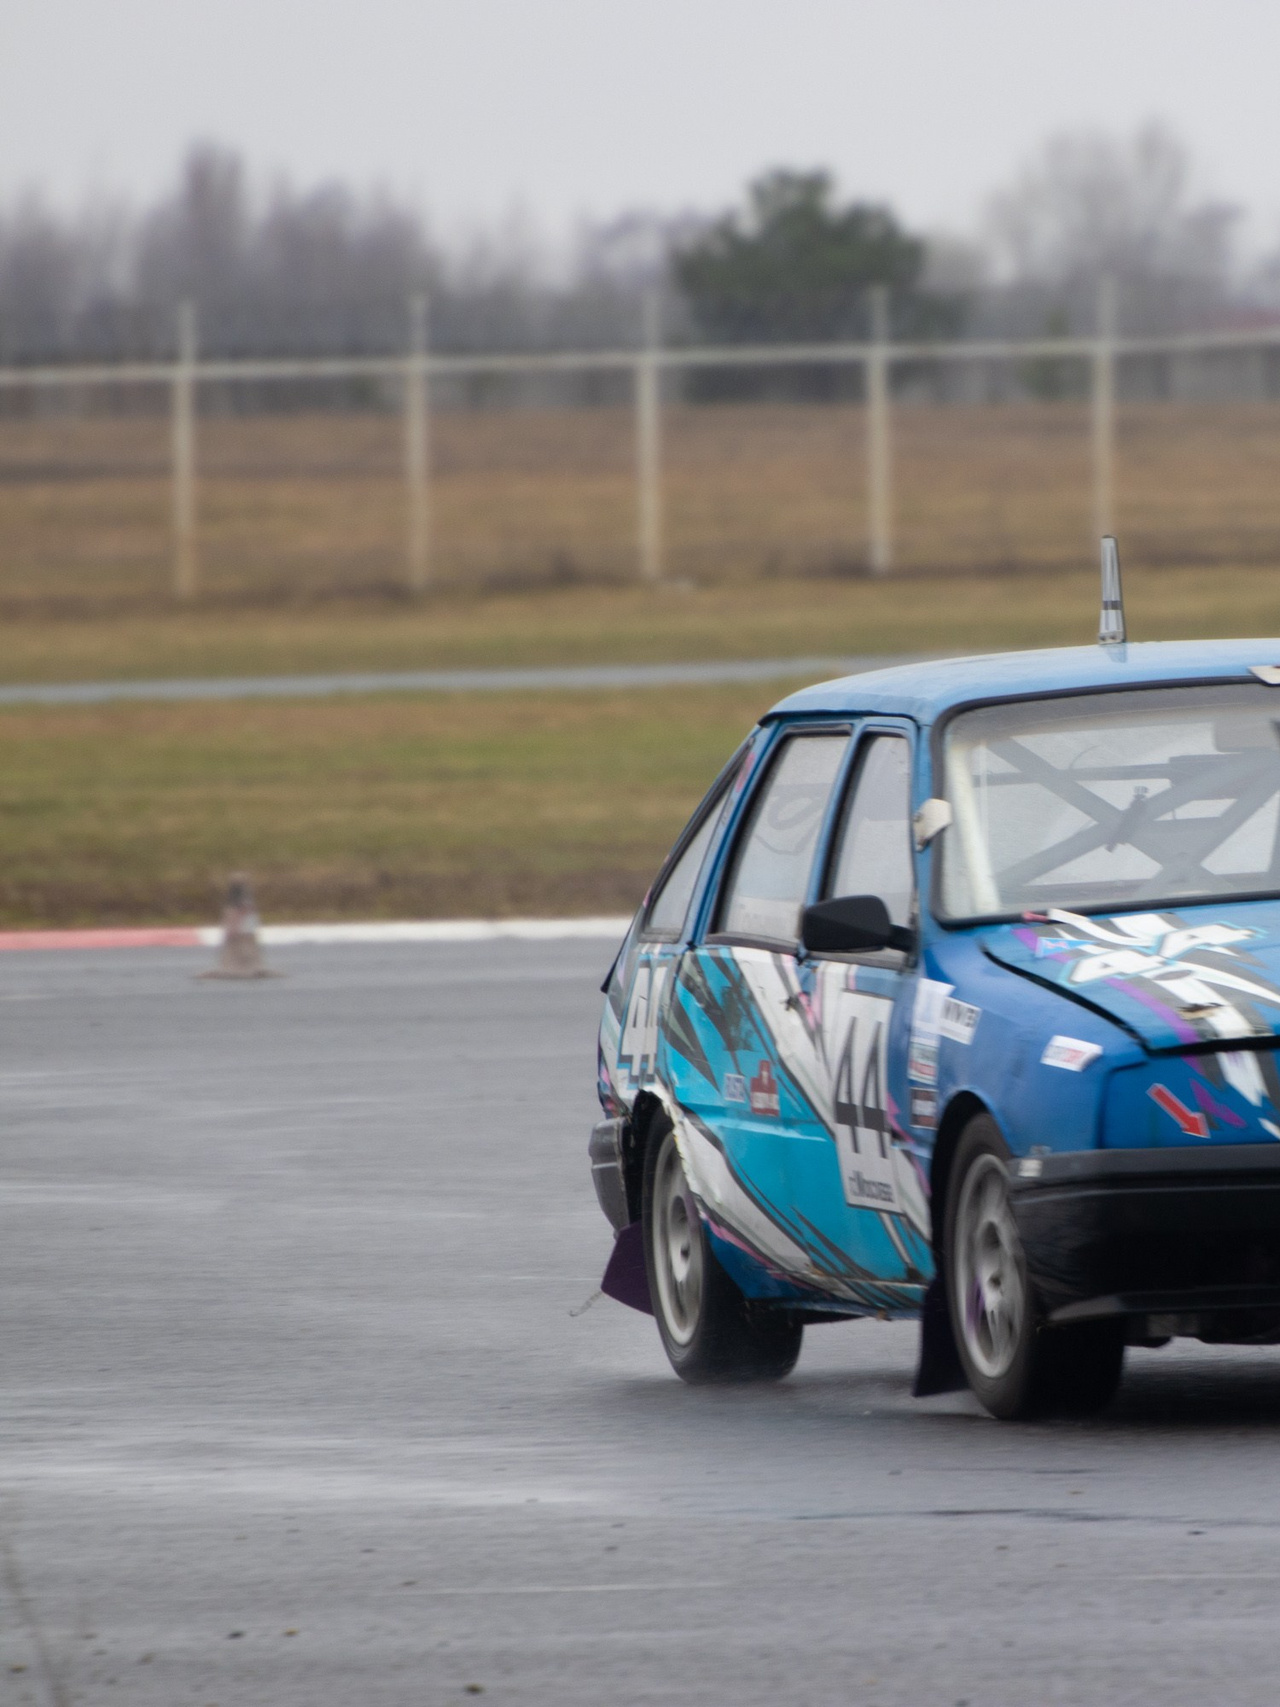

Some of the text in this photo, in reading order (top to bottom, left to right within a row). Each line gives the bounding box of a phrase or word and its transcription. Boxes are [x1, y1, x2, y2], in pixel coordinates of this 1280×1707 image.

[1067, 922, 1258, 984] 44
[618, 964, 669, 1078] 44
[834, 1016, 888, 1158] 44
